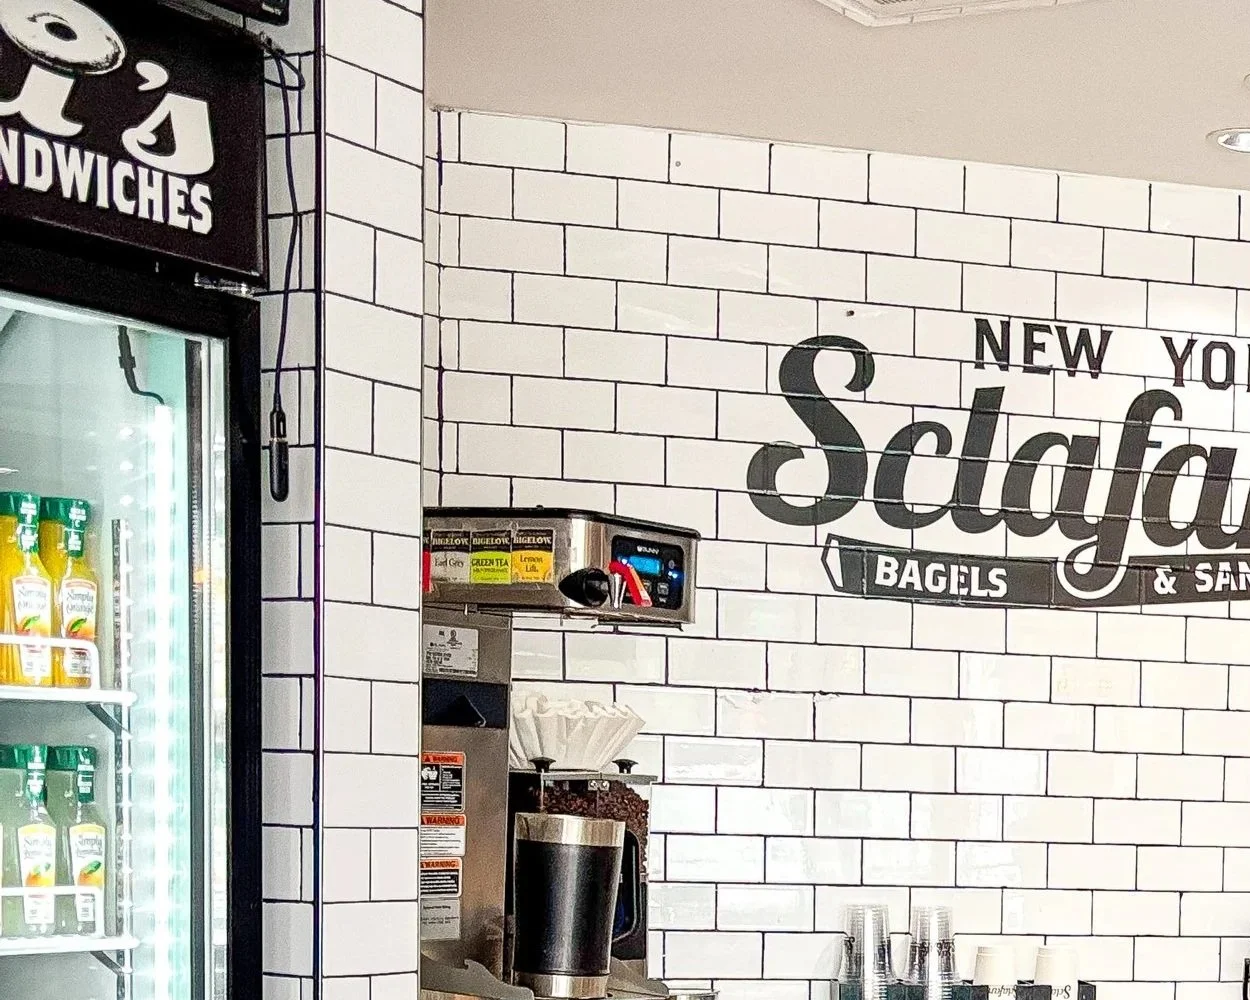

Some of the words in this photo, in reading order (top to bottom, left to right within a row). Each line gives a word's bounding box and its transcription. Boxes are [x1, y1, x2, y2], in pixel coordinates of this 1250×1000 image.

[974, 317, 1112, 380] NEW
[432, 537, 469, 546] BIGELOW
[472, 537, 511, 546] BIGELOW
[513, 536, 552, 545] BIGELOW
[471, 558, 496, 567] GREEN
[496, 558, 509, 567] TEA
[874, 554, 1009, 599] BAGELS
[1152, 564, 1179, 595] &
[425, 815, 460, 825] WARNING
